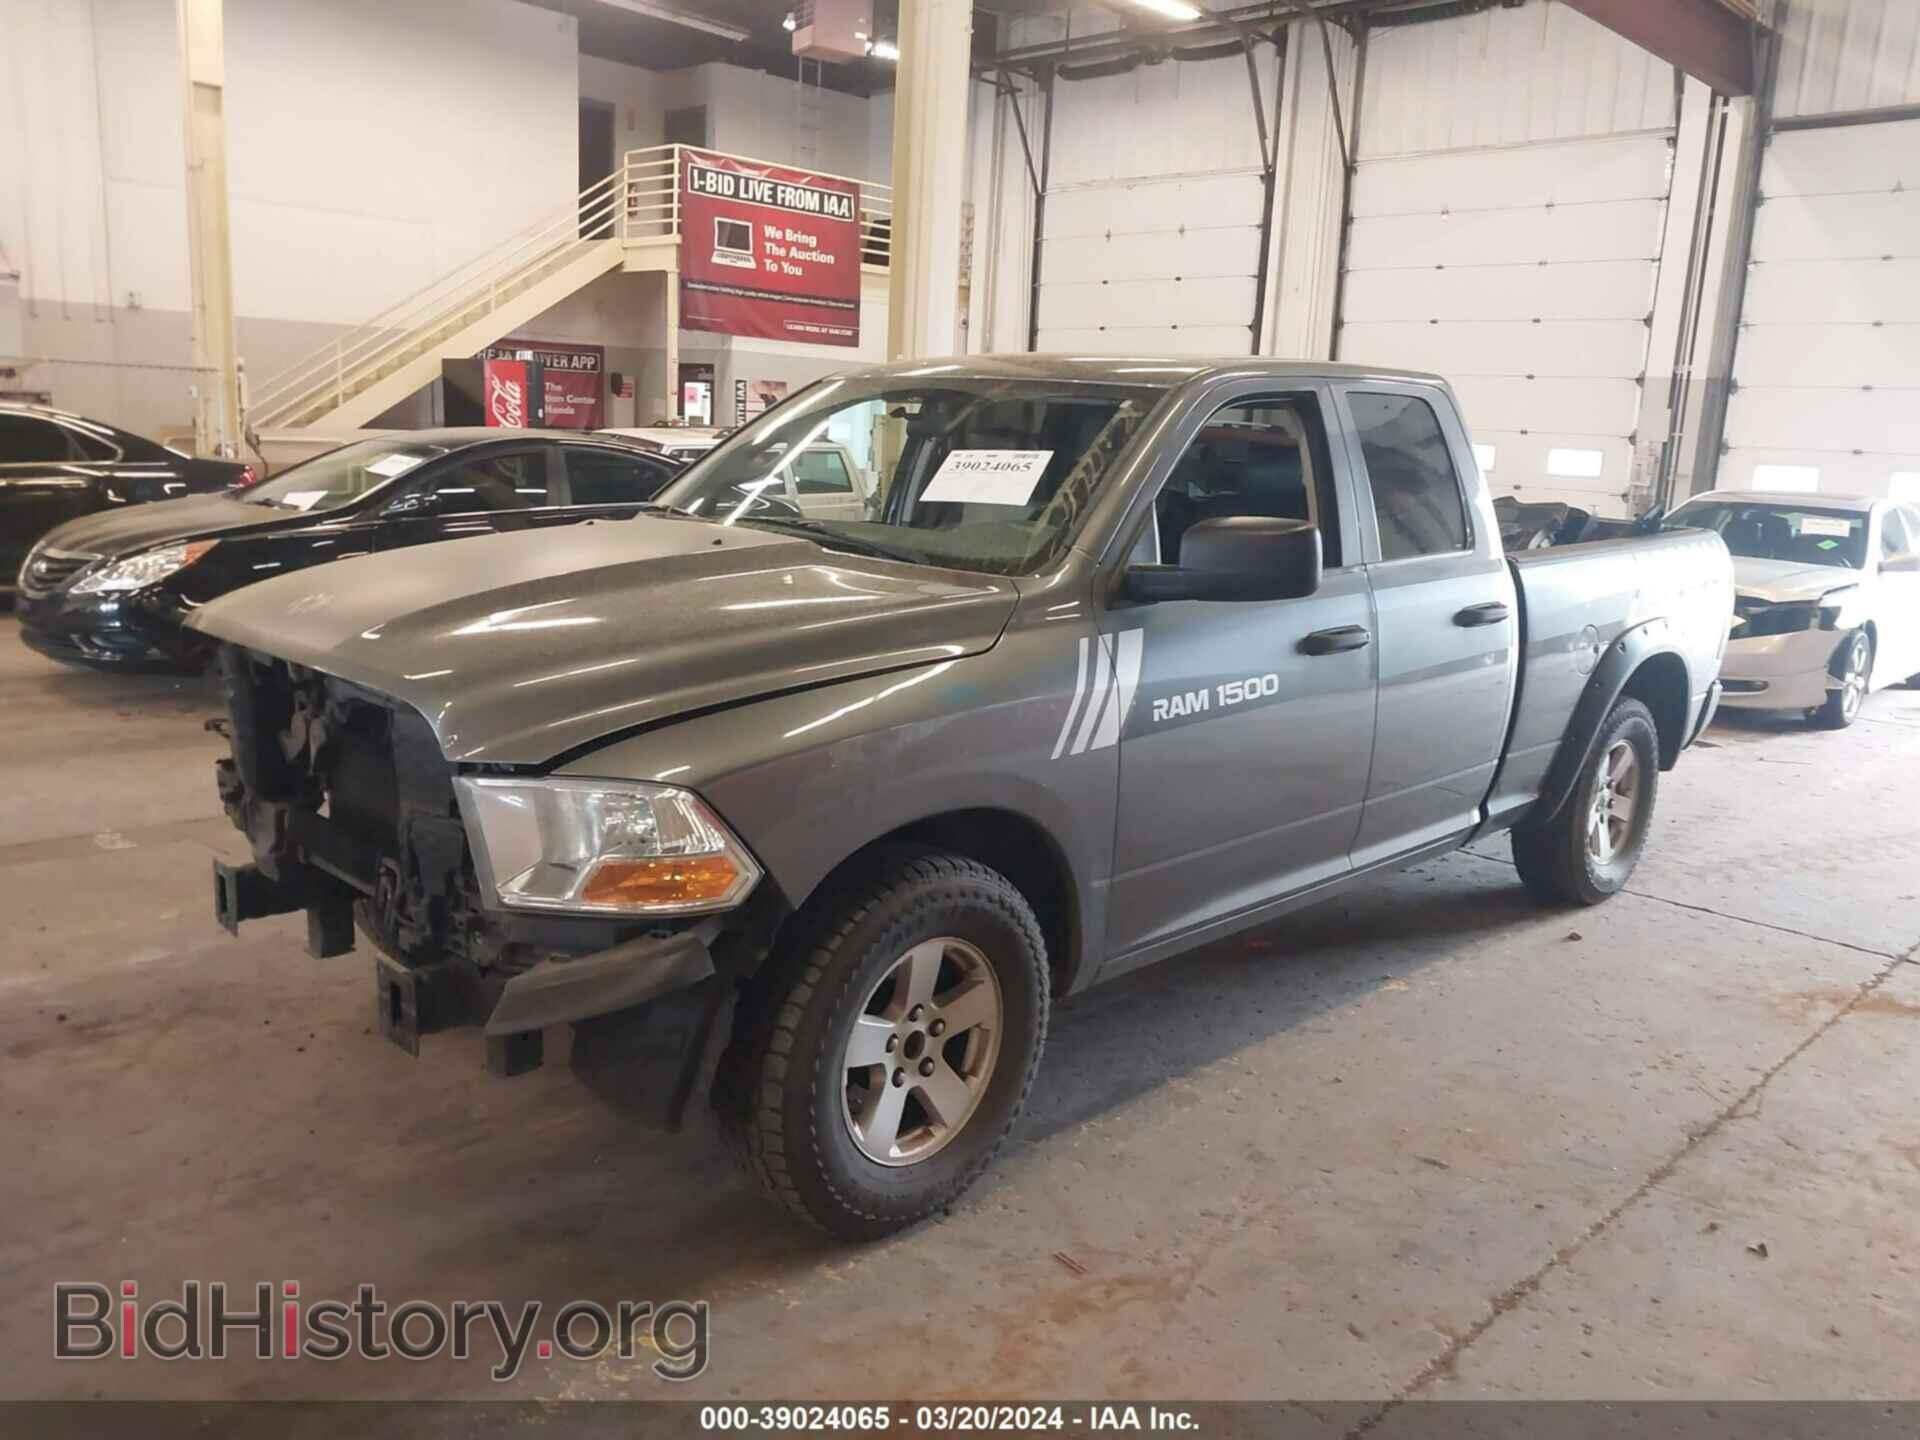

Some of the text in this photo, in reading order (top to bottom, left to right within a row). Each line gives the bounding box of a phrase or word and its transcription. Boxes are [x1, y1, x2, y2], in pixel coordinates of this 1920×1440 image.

[693, 168, 850, 217] I-BID LIVE FROM IAA
[764, 225, 817, 247] We Bring
[764, 242, 835, 264] The Auction
[764, 259, 803, 276] To You
[571, 356, 595, 369] APP
[950, 461, 1033, 473] 39024065
[1152, 673, 1279, 722] RAM 1500
